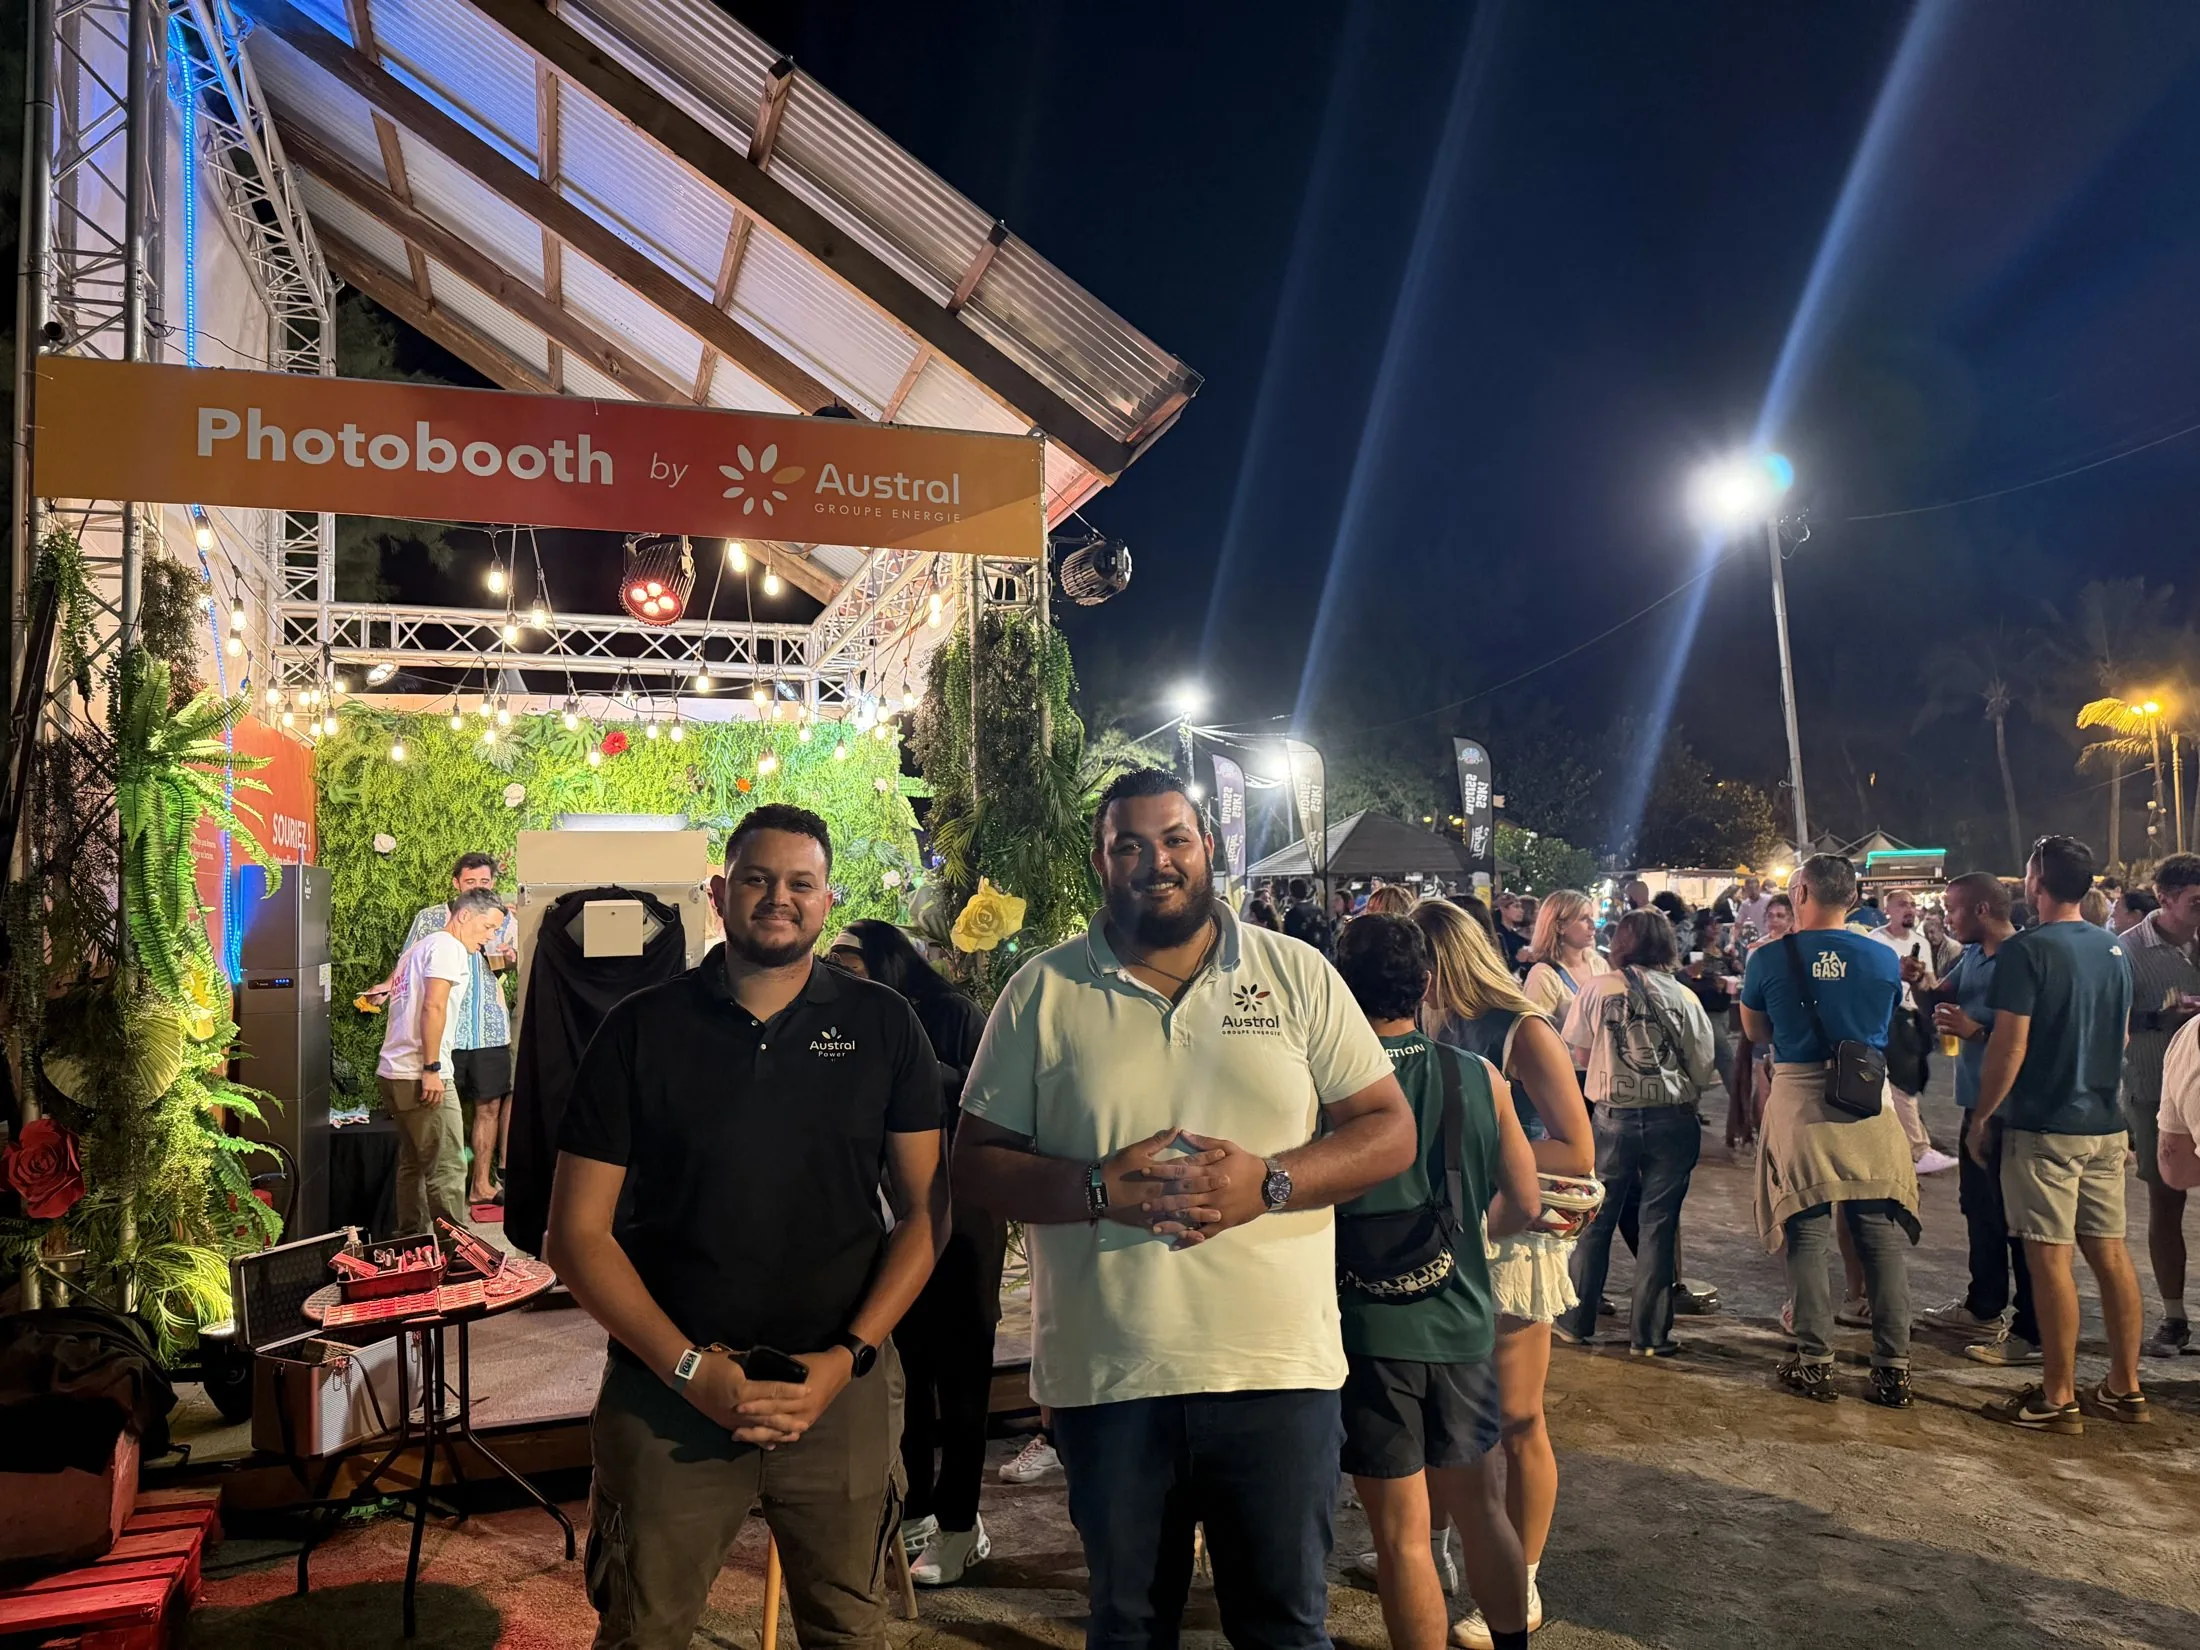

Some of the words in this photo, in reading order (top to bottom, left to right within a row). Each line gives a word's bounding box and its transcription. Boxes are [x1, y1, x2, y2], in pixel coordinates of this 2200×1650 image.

[197, 406, 615, 485] Photobooth
[649, 452, 689, 489] by
[814, 463, 960, 505] Austral
[814, 503, 882, 518] GROUPE
[892, 508, 961, 524] ENERGIE
[272, 812, 307, 850] SOURIEZ
[1812, 961, 1847, 978] GASY
[1222, 1015, 1279, 1028] Austral
[809, 1040, 856, 1050] Austral
[1385, 1043, 1426, 1058] CTION
